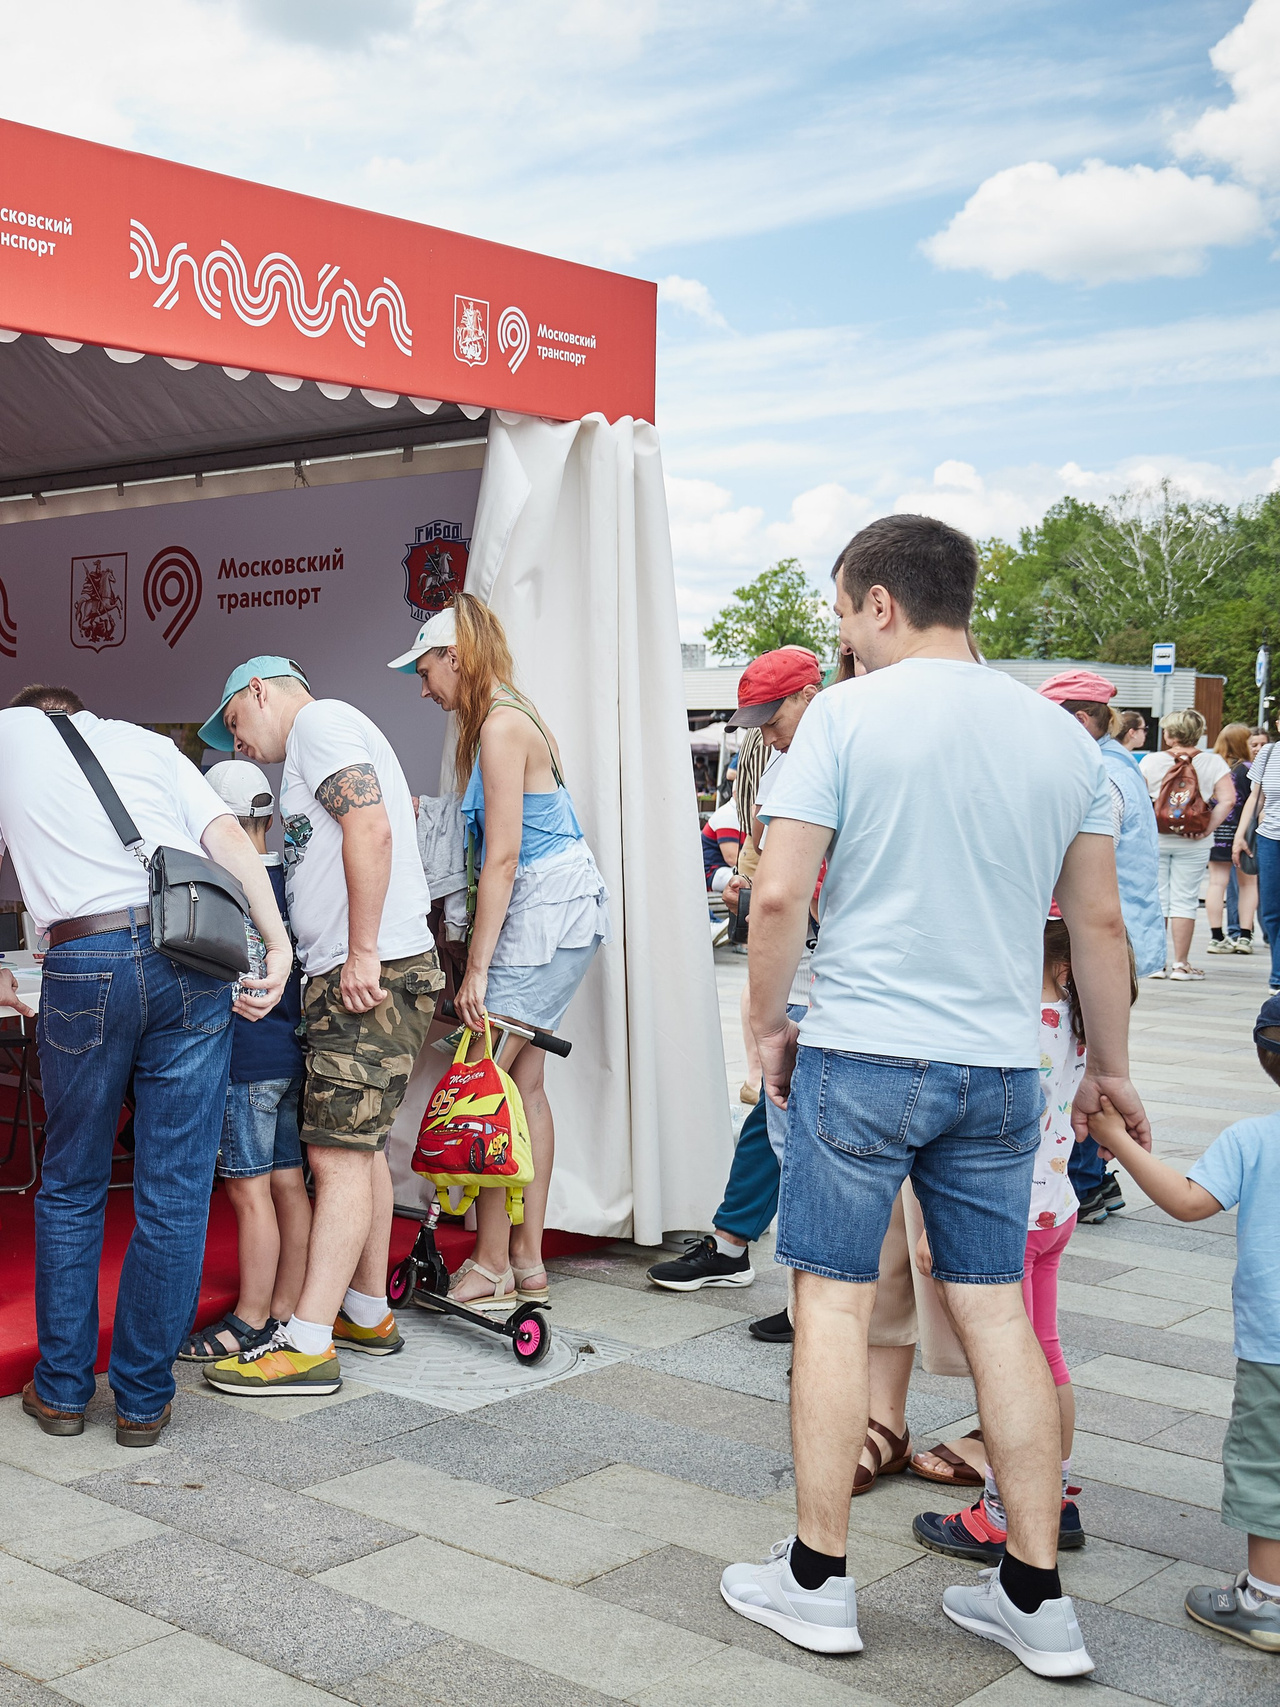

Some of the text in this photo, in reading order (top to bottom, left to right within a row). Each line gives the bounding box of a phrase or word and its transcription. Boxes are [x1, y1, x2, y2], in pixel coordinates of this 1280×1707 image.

[537, 323, 597, 349] Московский
[536, 345, 587, 367] транспорт
[417, 522, 460, 542] ГИБДД
[217, 547, 344, 580] Московский
[217, 587, 322, 614] транспорт
[427, 1087, 460, 1118] 95
